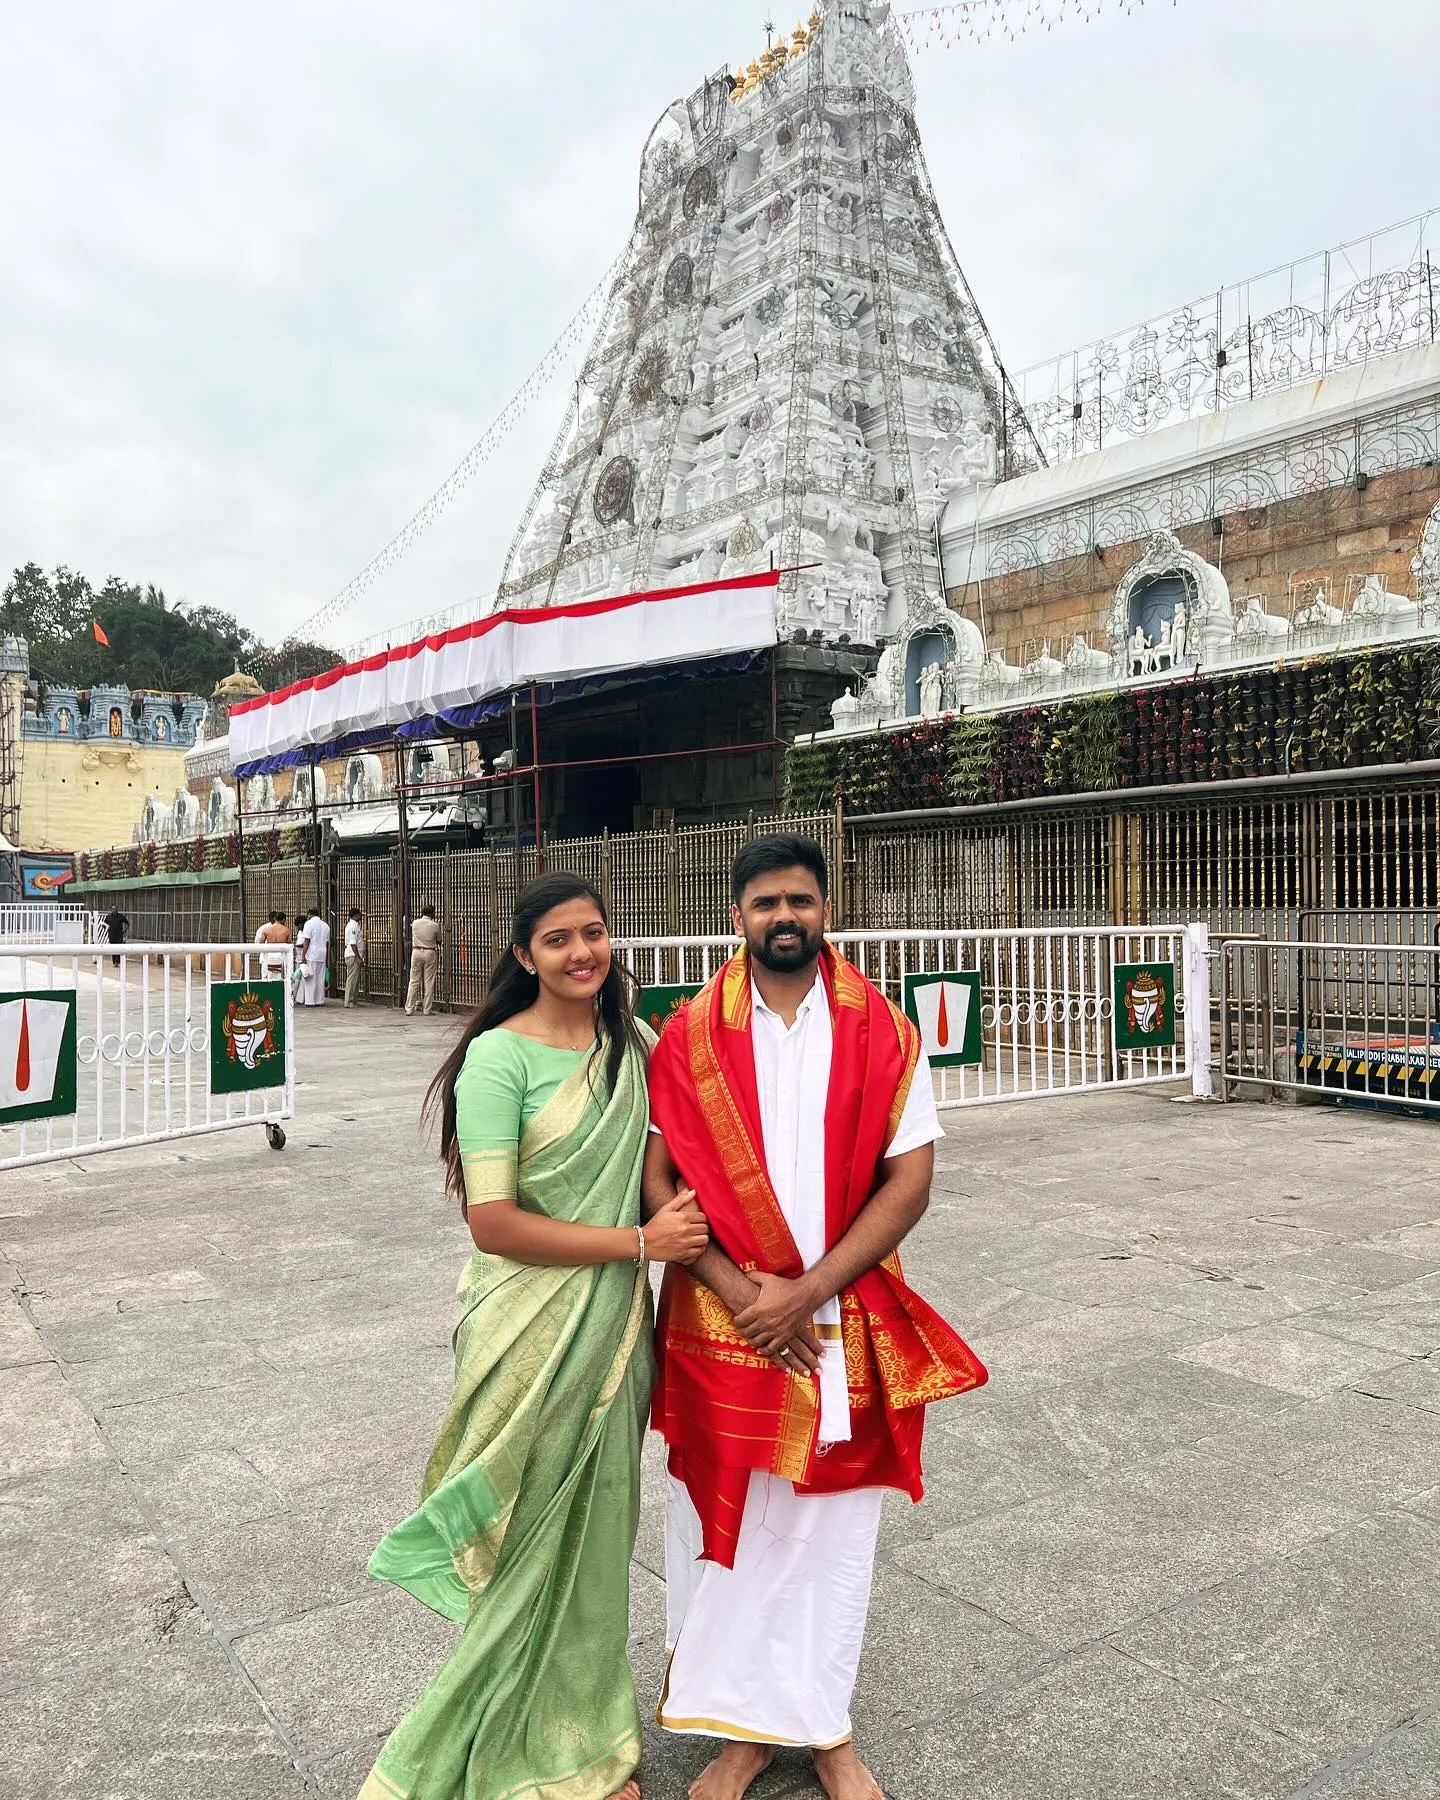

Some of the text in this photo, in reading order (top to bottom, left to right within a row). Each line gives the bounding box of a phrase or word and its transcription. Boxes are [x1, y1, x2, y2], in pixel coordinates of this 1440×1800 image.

[1316, 1044, 1334, 1052] SEVICE
[1346, 1048, 1381, 1061] ALIPDDI
[1381, 1052, 1426, 1066] PRABHKAR
